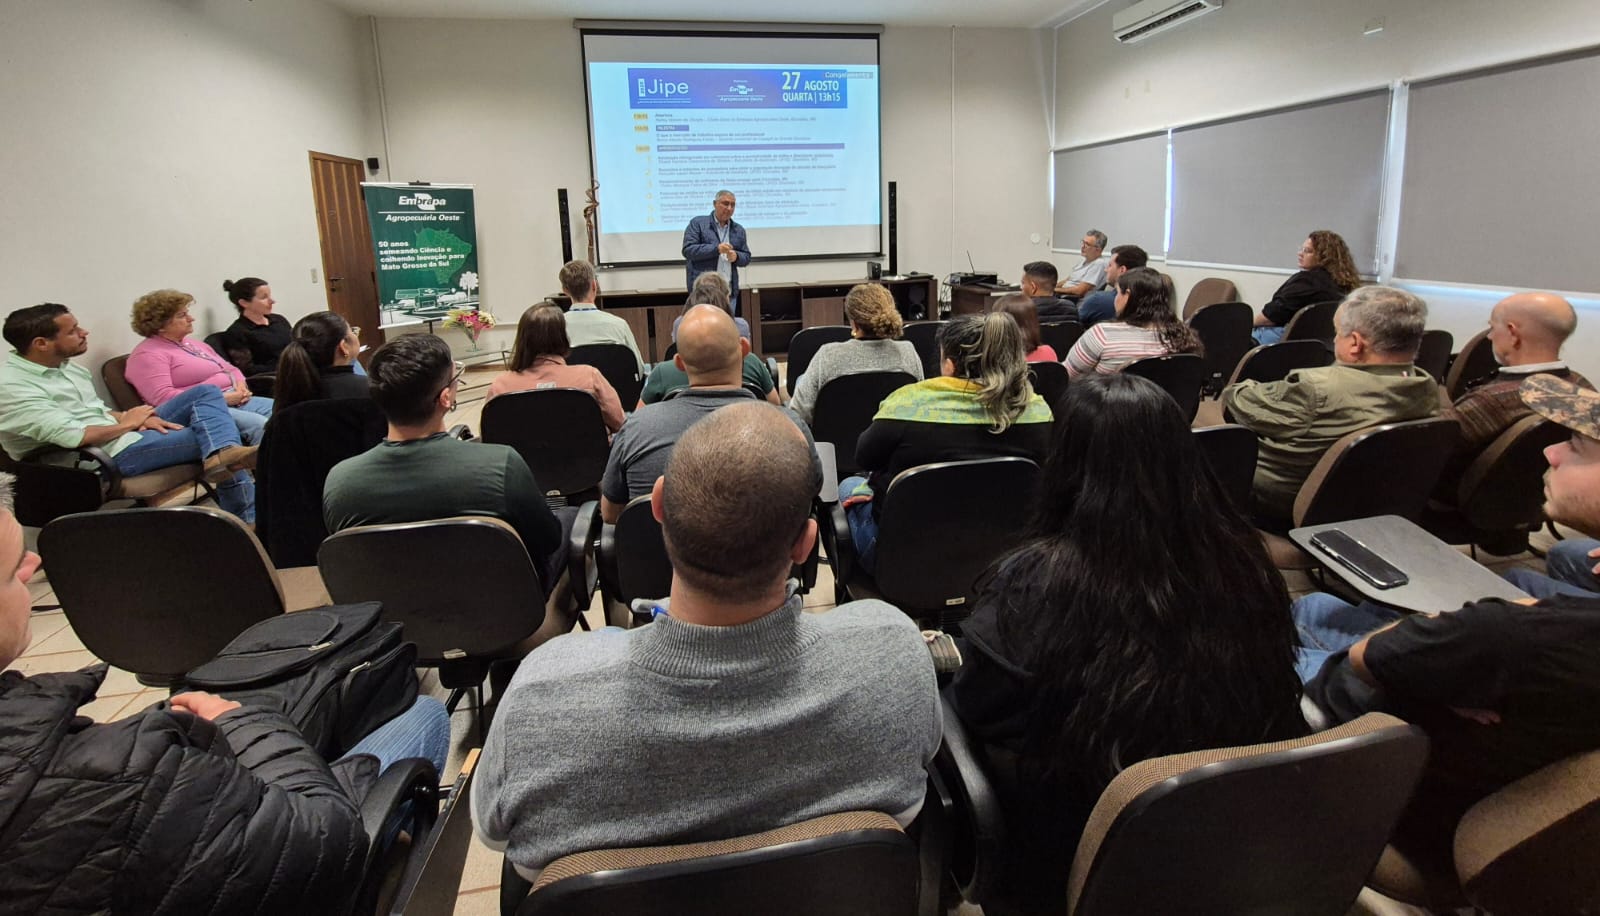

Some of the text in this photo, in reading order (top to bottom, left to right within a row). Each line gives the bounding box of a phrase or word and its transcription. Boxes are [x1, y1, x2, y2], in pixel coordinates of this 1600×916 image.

[781, 71, 839, 91] 27 AGOSTO
[647, 79, 689, 97] Jipe
[782, 92, 841, 102] QUARTA 13h15
[398, 195, 447, 207] Embrapa
[385, 214, 437, 222] Agropecuária
[380, 255, 416, 263] colhendo
[416, 253, 447, 262] Inovação
